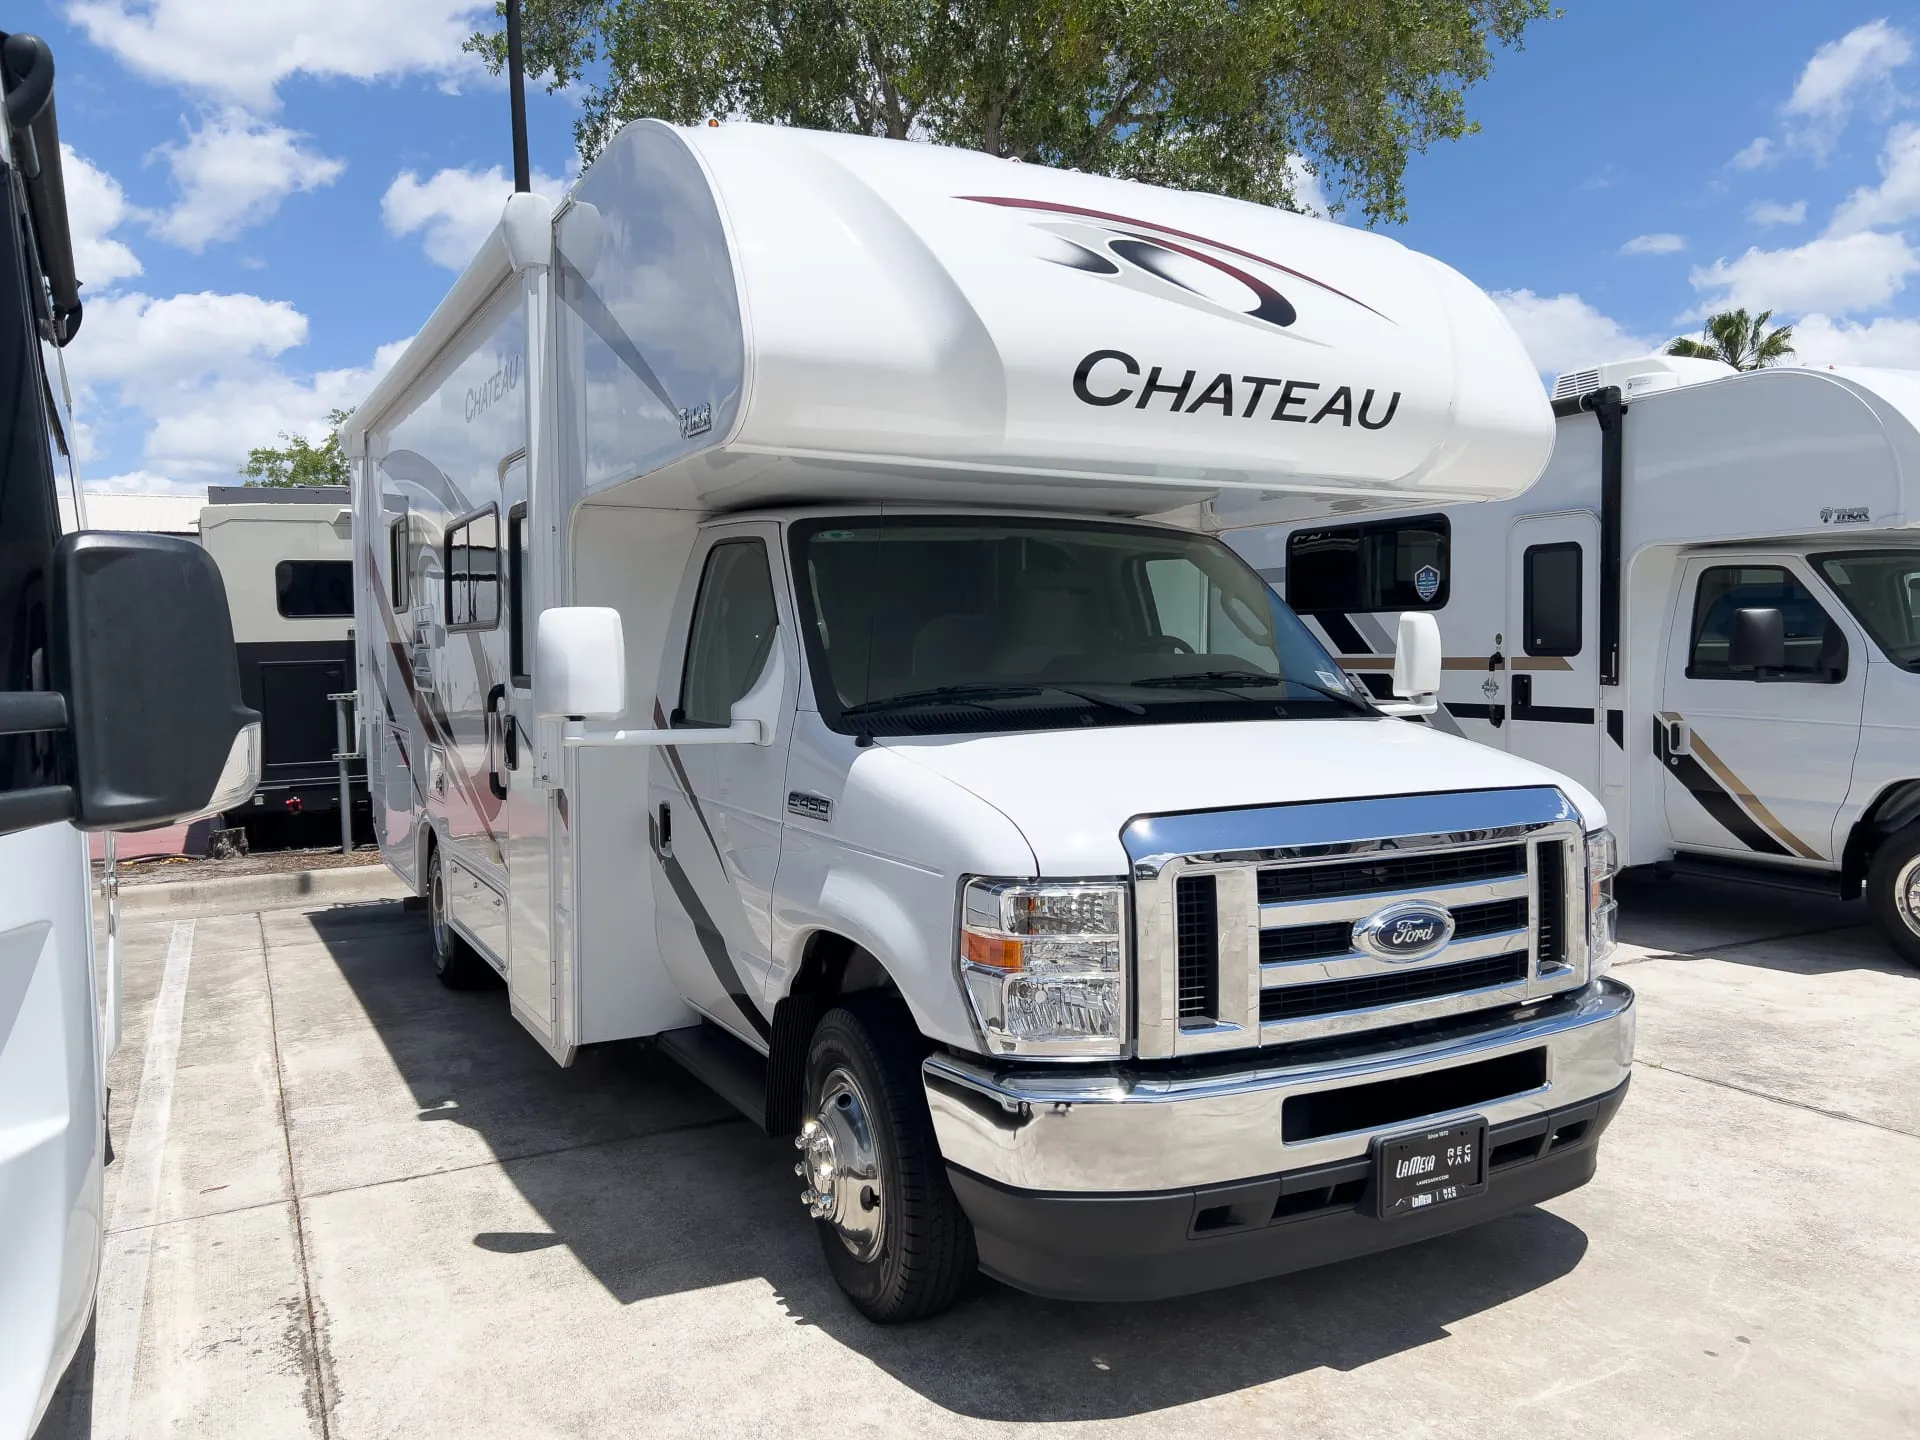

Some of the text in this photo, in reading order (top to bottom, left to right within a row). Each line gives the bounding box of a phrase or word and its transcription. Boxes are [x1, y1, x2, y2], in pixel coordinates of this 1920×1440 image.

[465, 355, 519, 424] CHATEAU
[1072, 349, 1402, 430] CHATEAU
[1833, 506, 1870, 521] THOR
[1392, 918, 1434, 944] Ford
[1447, 1144, 1472, 1157] REC
[1447, 1154, 1471, 1167] VAN
